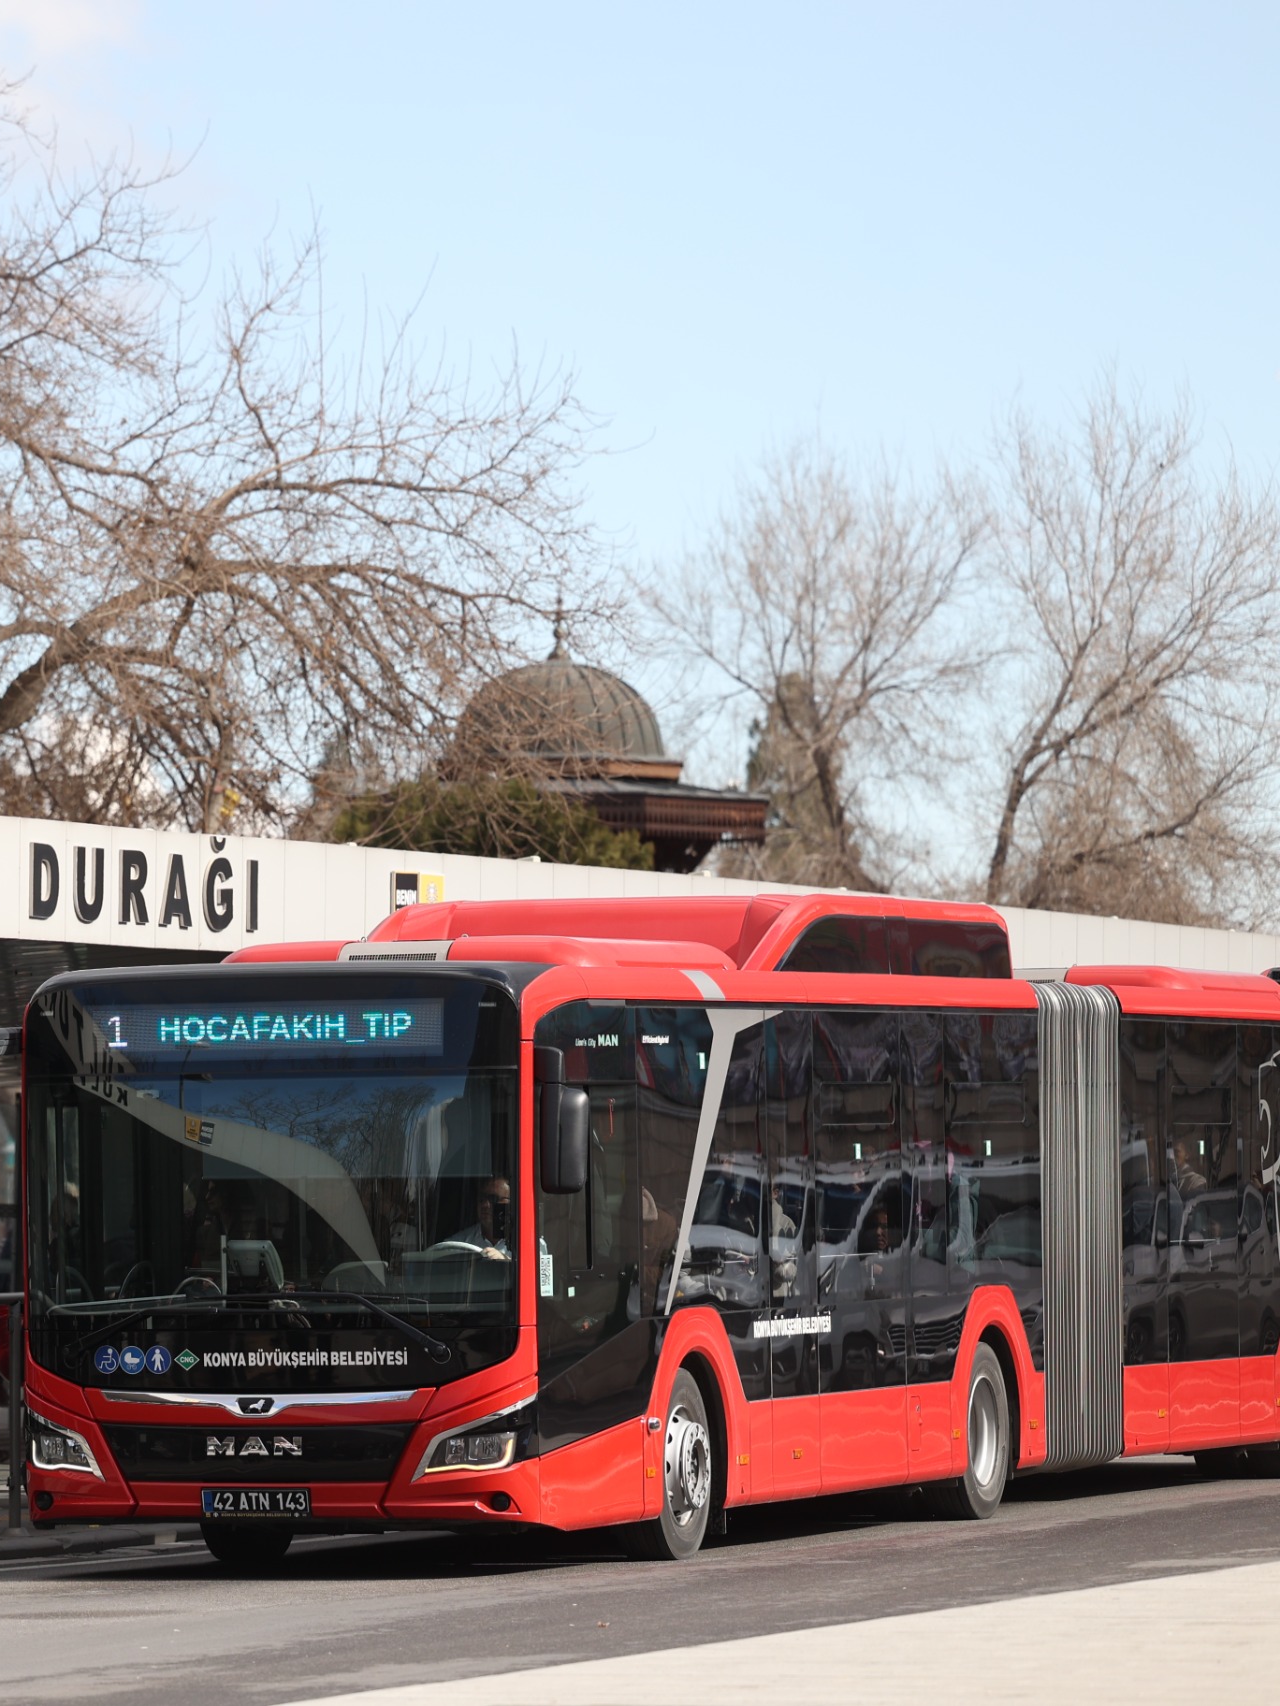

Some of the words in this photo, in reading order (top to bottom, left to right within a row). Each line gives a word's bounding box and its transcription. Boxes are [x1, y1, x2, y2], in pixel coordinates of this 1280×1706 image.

[28, 837, 259, 932] DURAĞI
[108, 1015, 128, 1048] 1
[597, 1034, 619, 1047] MAN
[179, 1356, 195, 1364] CNG
[203, 1352, 246, 1367] KONYA
[248, 1348, 329, 1368] BÜYÜKŞEHİR
[330, 1347, 408, 1366] BELEDİYESİ
[206, 1435, 303, 1457] MAN
[213, 1492, 234, 1511] 42
[239, 1492, 270, 1511] ATN
[276, 1492, 307, 1511] 143
